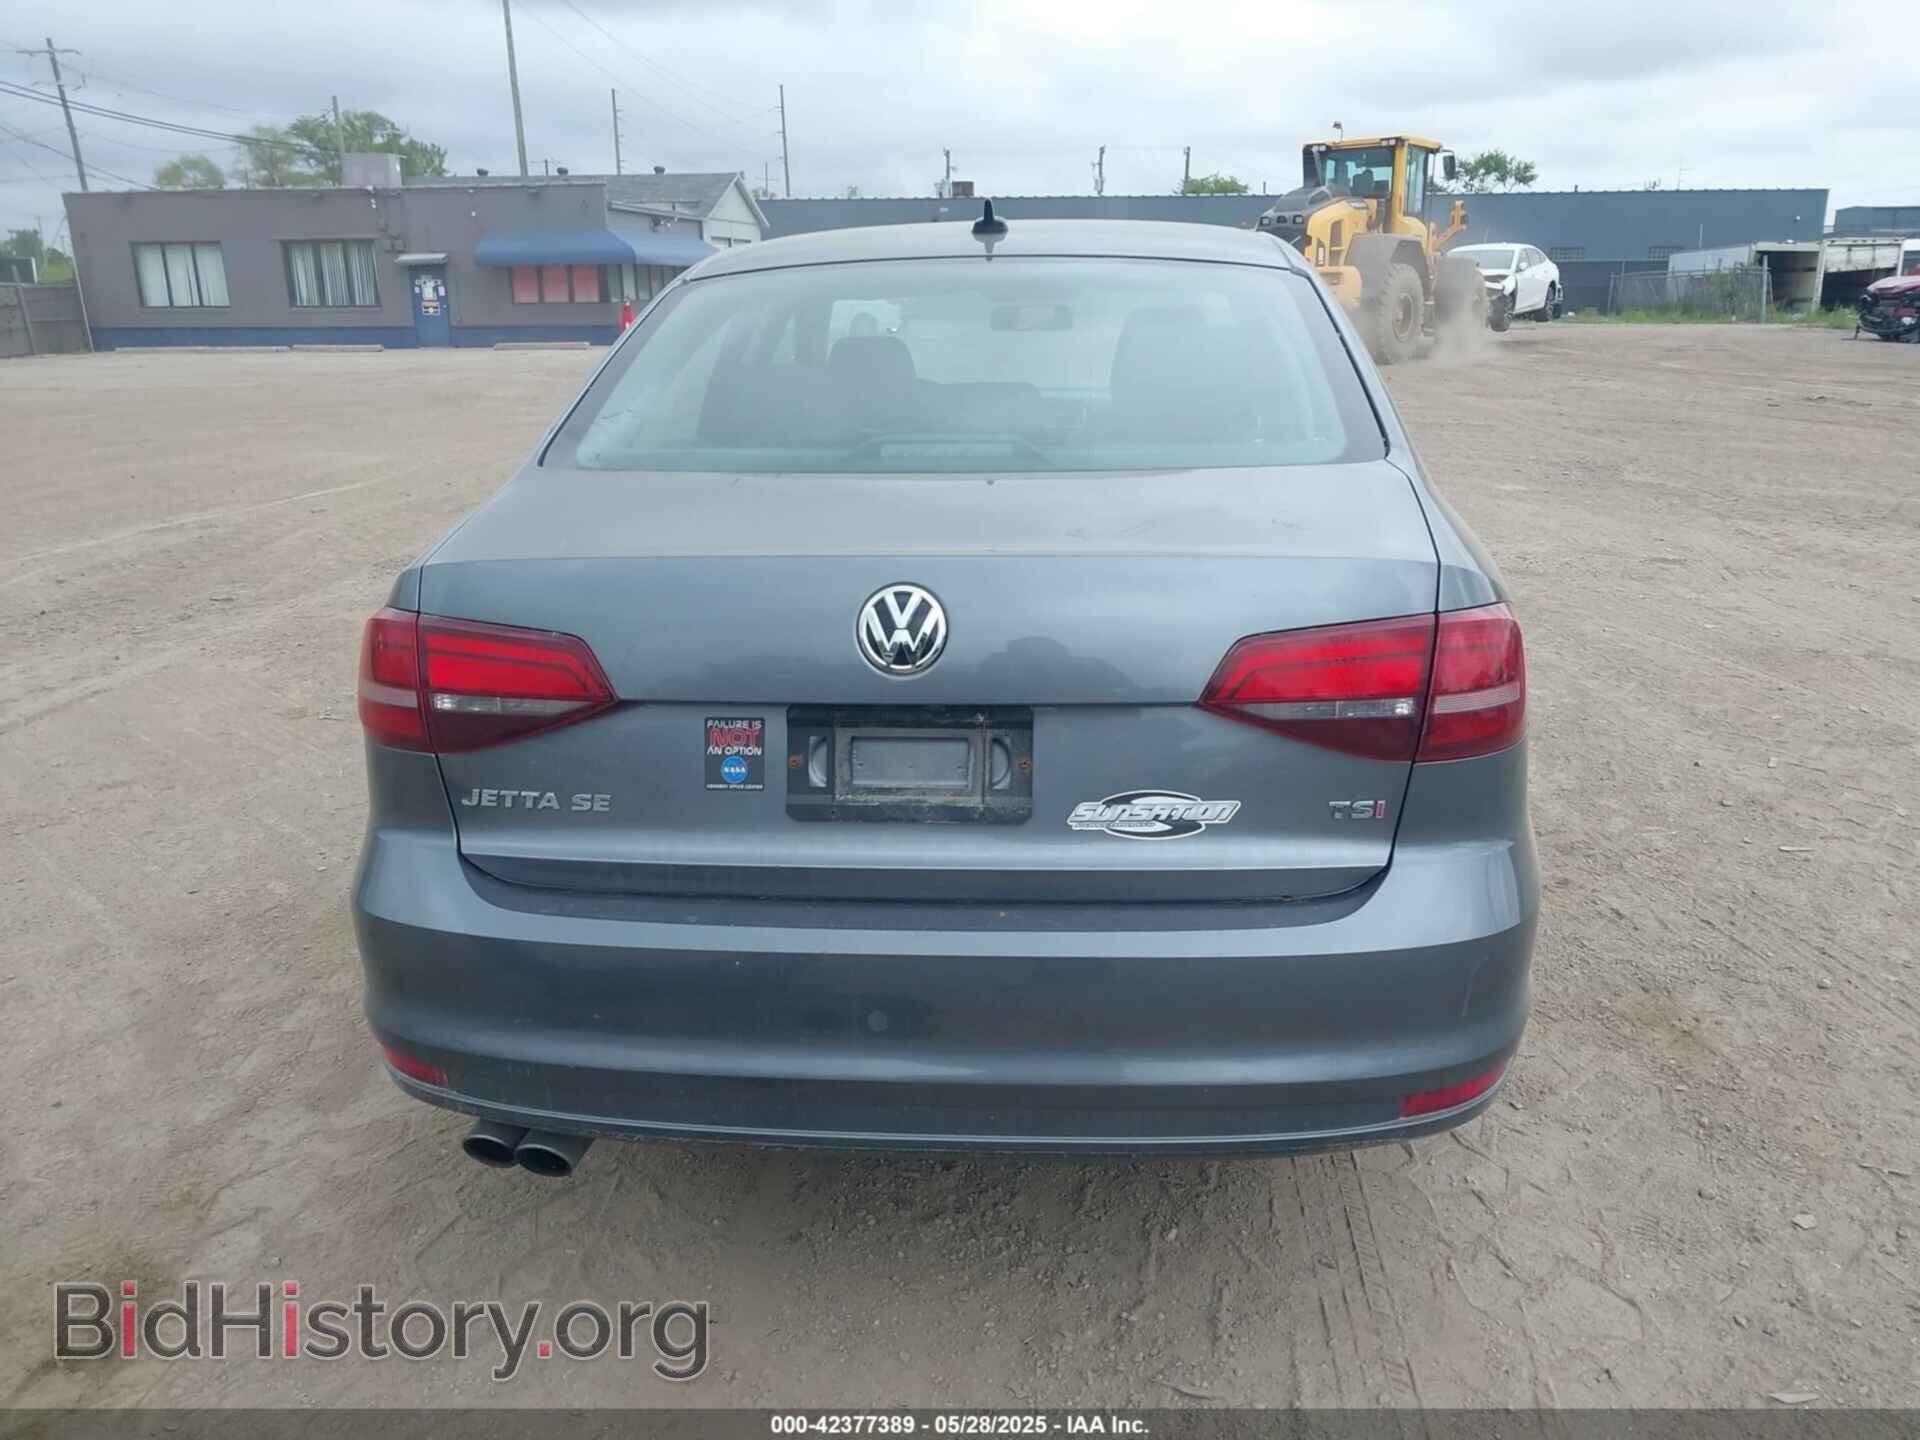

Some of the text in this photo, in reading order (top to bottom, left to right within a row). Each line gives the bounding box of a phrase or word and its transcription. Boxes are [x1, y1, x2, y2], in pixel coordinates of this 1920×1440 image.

[707, 719, 762, 729] FAILURE IS
[709, 728, 760, 749] NOT
[706, 746, 762, 756] AN OPTION
[461, 788, 611, 812] JETTA SE
